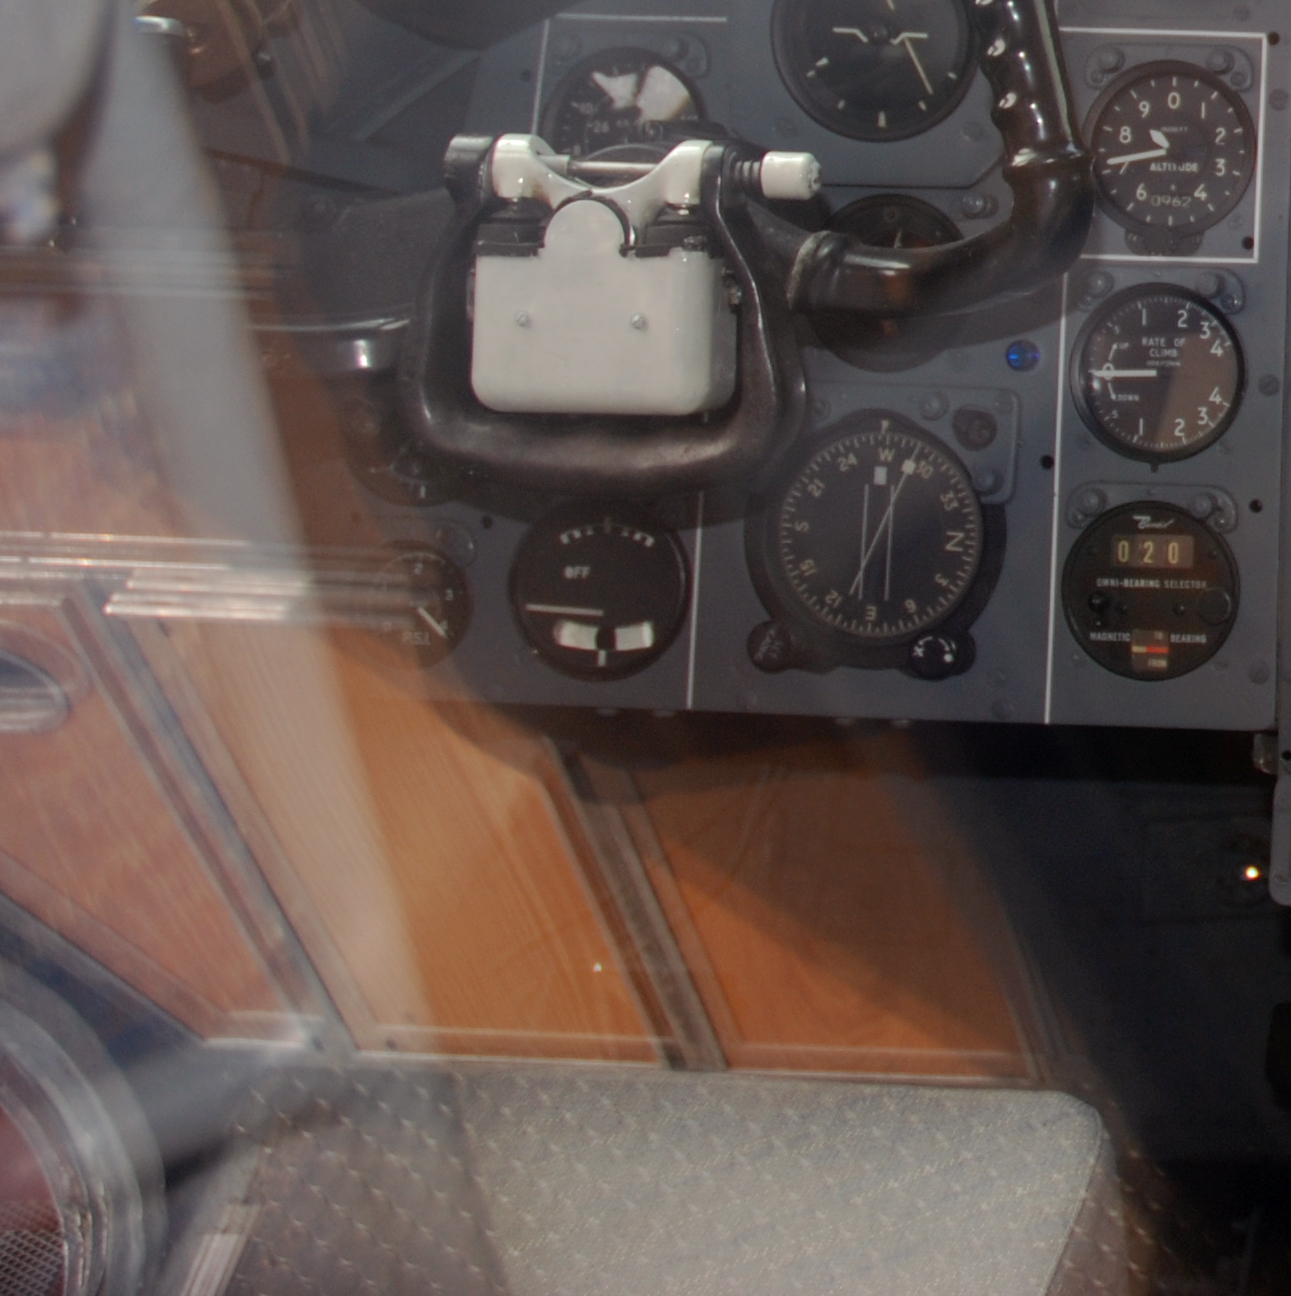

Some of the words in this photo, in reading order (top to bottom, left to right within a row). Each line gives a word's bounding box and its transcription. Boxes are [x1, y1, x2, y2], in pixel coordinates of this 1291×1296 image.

[1168, 92, 1180, 109] 0
[1138, 101, 1150, 118] 9
[1119, 126, 1132, 143] 8
[1215, 128, 1225, 145] 2
[1216, 158, 1226, 177] 3
[1136, 183, 1147, 200] 6
[1194, 184, 1208, 200] 4
[1177, 310, 1188, 328] 2
[1200, 321, 1211, 339] 3
[1141, 338, 1166, 346] RATE
[1173, 338, 1186, 346] OF
[1210, 340, 1223, 356] 4
[1150, 348, 1178, 357] CLIMB
[1209, 387, 1222, 404] 4
[1198, 407, 1209, 425] 3
[1174, 419, 1185, 436] 2
[945, 532, 964, 552] N
[1118, 540, 1179, 564] 020
[564, 565, 591, 579] OFF
[1097, 578, 1160, 588] OMNI-BEARING
[1164, 580, 1206, 589] SELECTOR
[1090, 632, 1131, 642] MAGNETIC
[1170, 634, 1207, 643] BEARING
